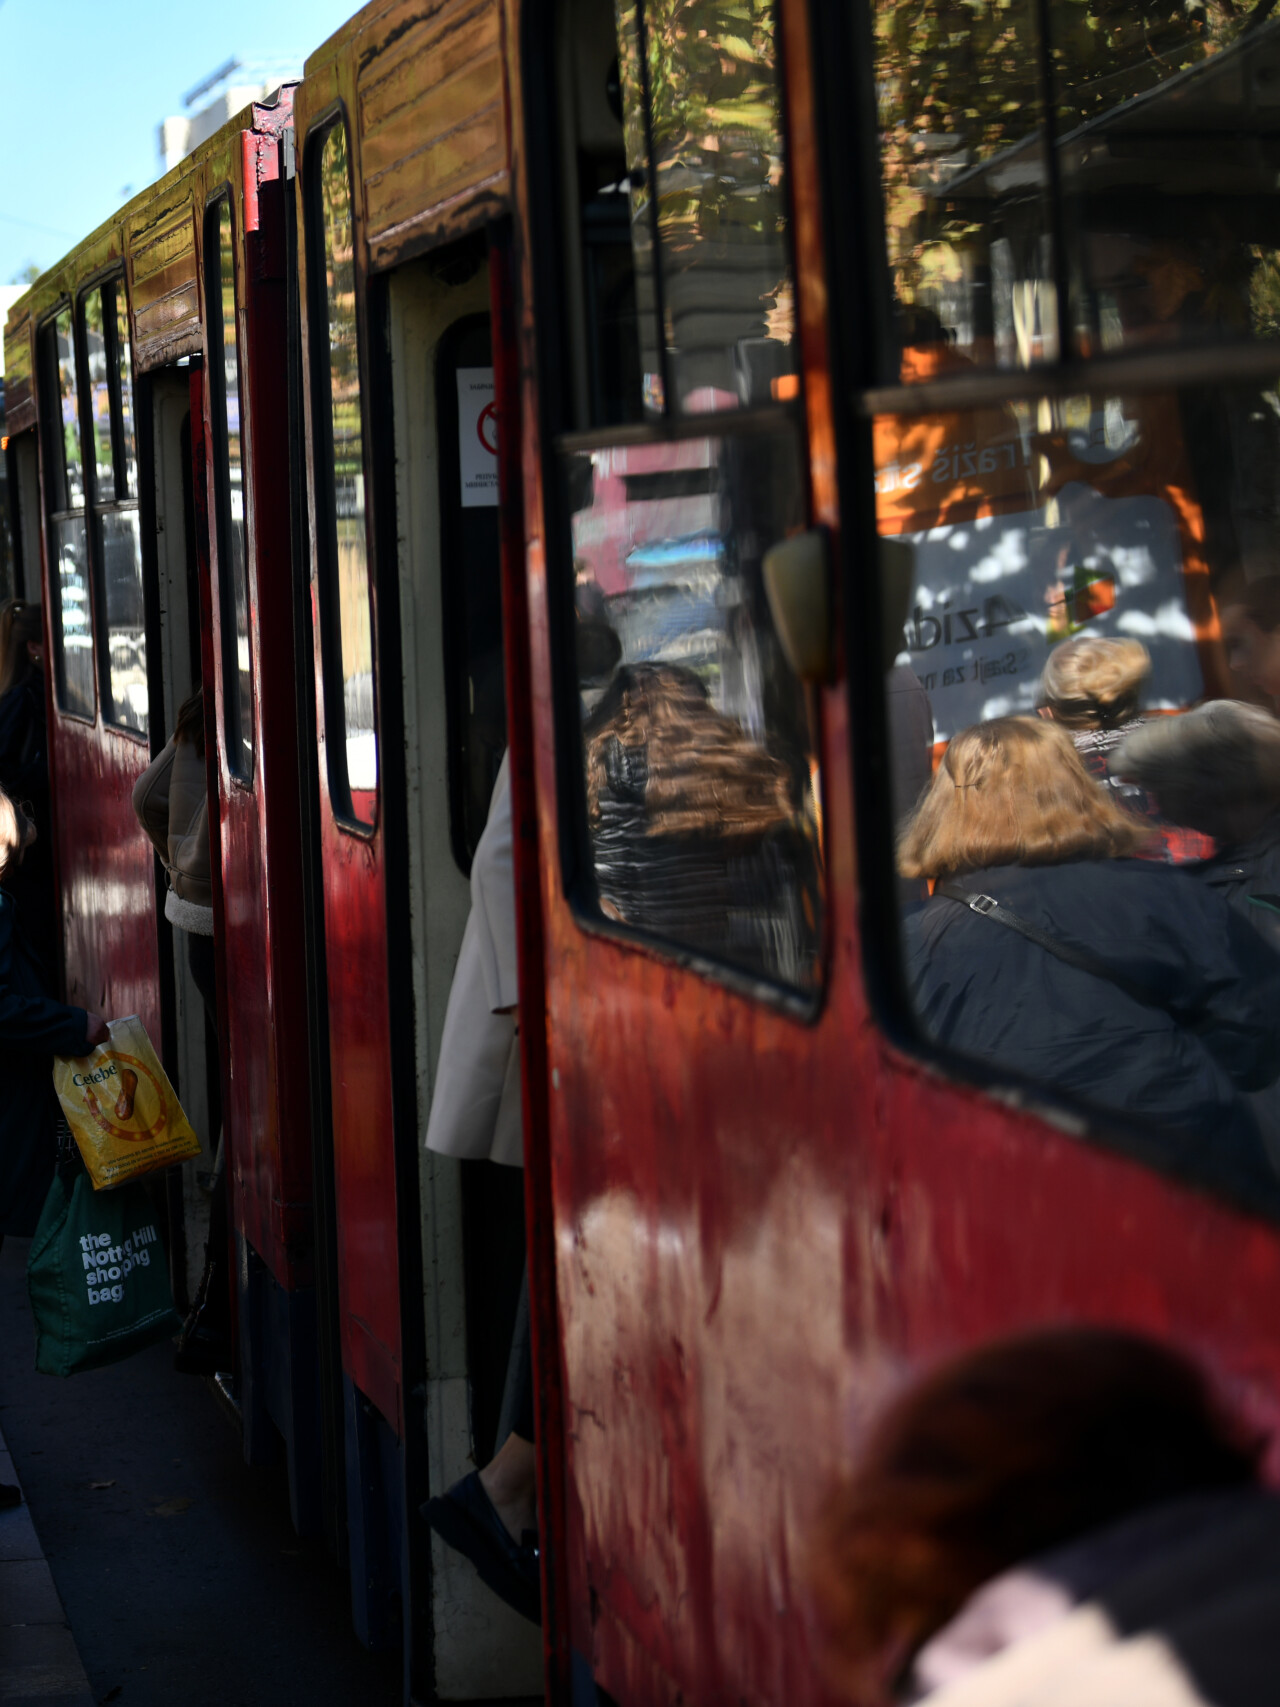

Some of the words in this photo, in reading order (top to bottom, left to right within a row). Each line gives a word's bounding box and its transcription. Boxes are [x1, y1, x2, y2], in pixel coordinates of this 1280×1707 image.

[73, 1063, 118, 1087] Cetebe
[79, 1232, 112, 1252] the
[81, 1238, 133, 1270] Nottg
[132, 1224, 158, 1248] Hill
[86, 1249, 151, 1286] shopng
